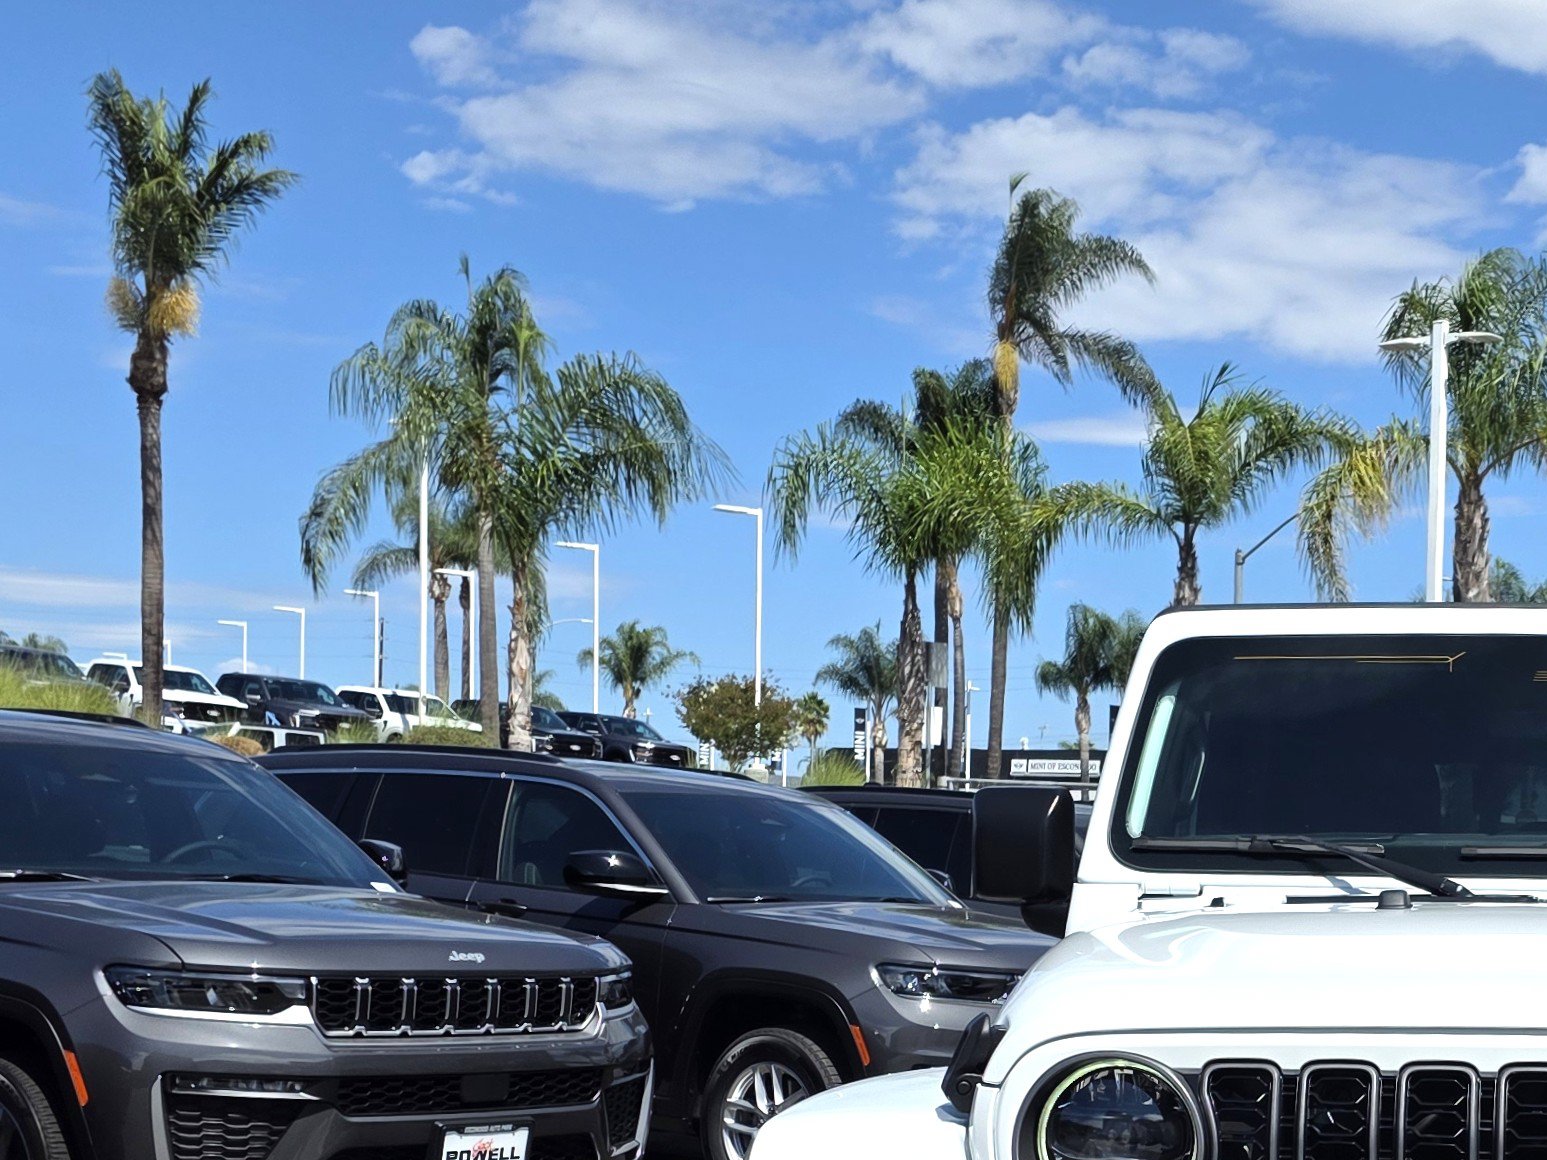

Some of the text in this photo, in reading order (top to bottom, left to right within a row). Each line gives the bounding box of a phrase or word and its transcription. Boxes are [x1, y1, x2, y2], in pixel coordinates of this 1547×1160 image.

[699, 740, 710, 765] MIN
[854, 730, 866, 760] MINI
[1030, 763, 1046, 771] MINI
[448, 950, 486, 963] Jeep
